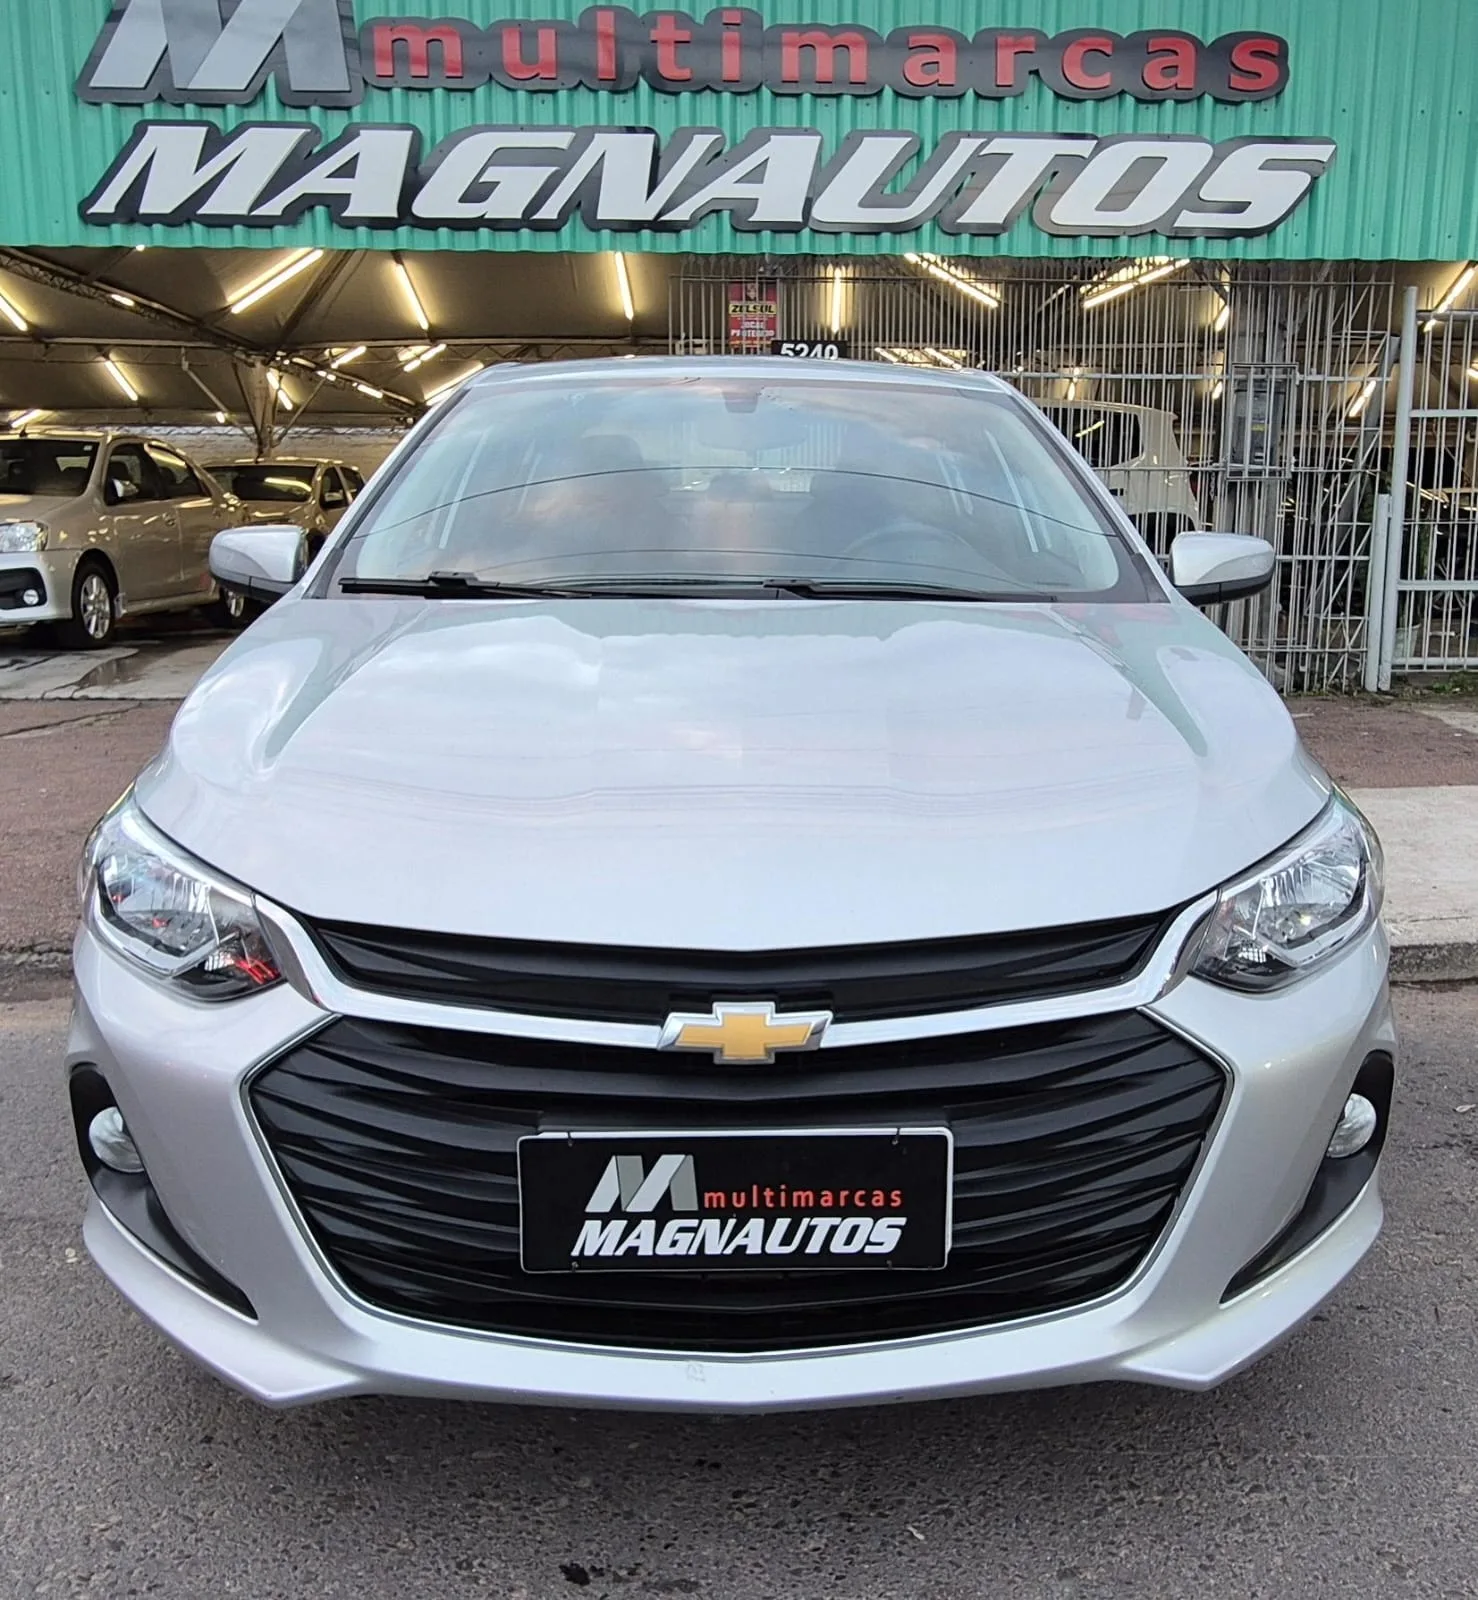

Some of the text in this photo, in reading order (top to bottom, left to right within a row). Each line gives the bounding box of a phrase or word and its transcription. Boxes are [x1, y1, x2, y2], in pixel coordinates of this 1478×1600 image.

[373, 9, 1282, 91] multimarcas
[87, 125, 1337, 229] MAGNAUTOS
[781, 342, 839, 360] 5240
[703, 1184, 902, 1208] multimarcas
[570, 1216, 907, 1257] MAGNAUTOS
